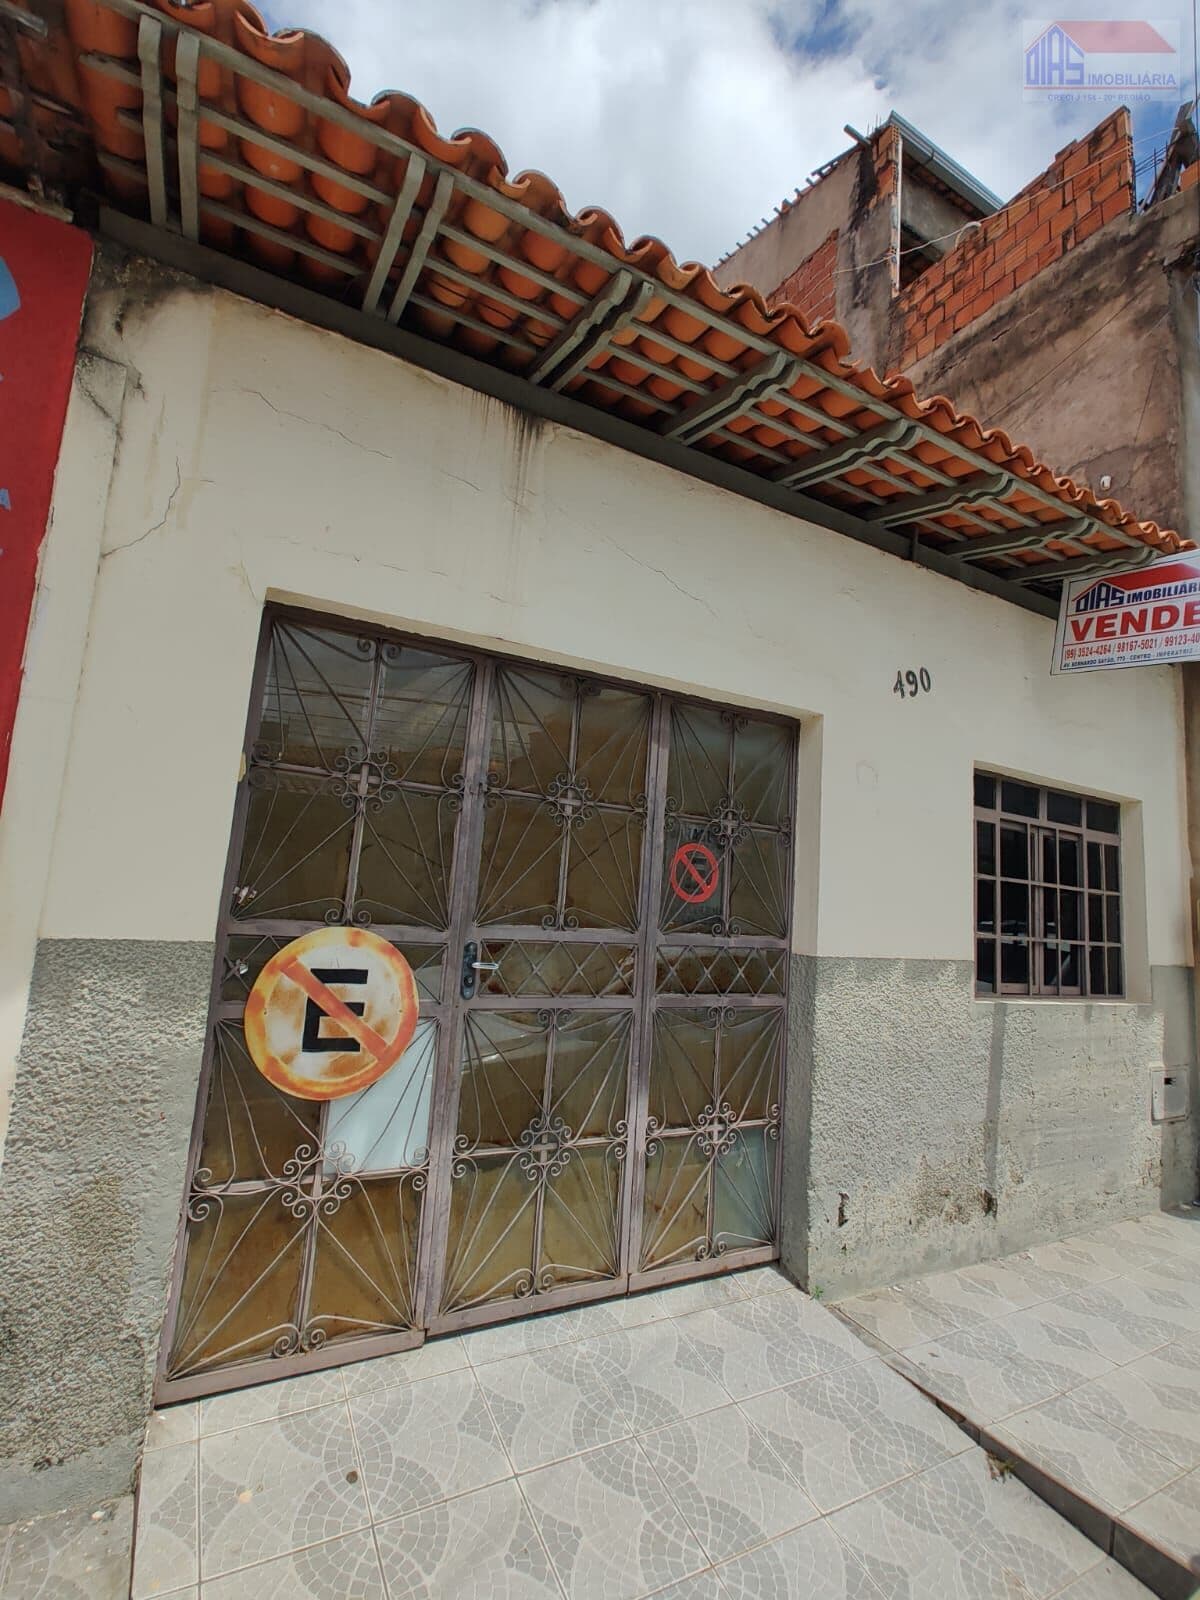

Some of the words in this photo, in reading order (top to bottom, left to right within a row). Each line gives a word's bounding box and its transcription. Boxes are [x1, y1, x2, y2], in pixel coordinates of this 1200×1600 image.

[1075, 582, 1124, 612] DIAS
[893, 666, 932, 699] 490
[302, 968, 369, 1053] E
